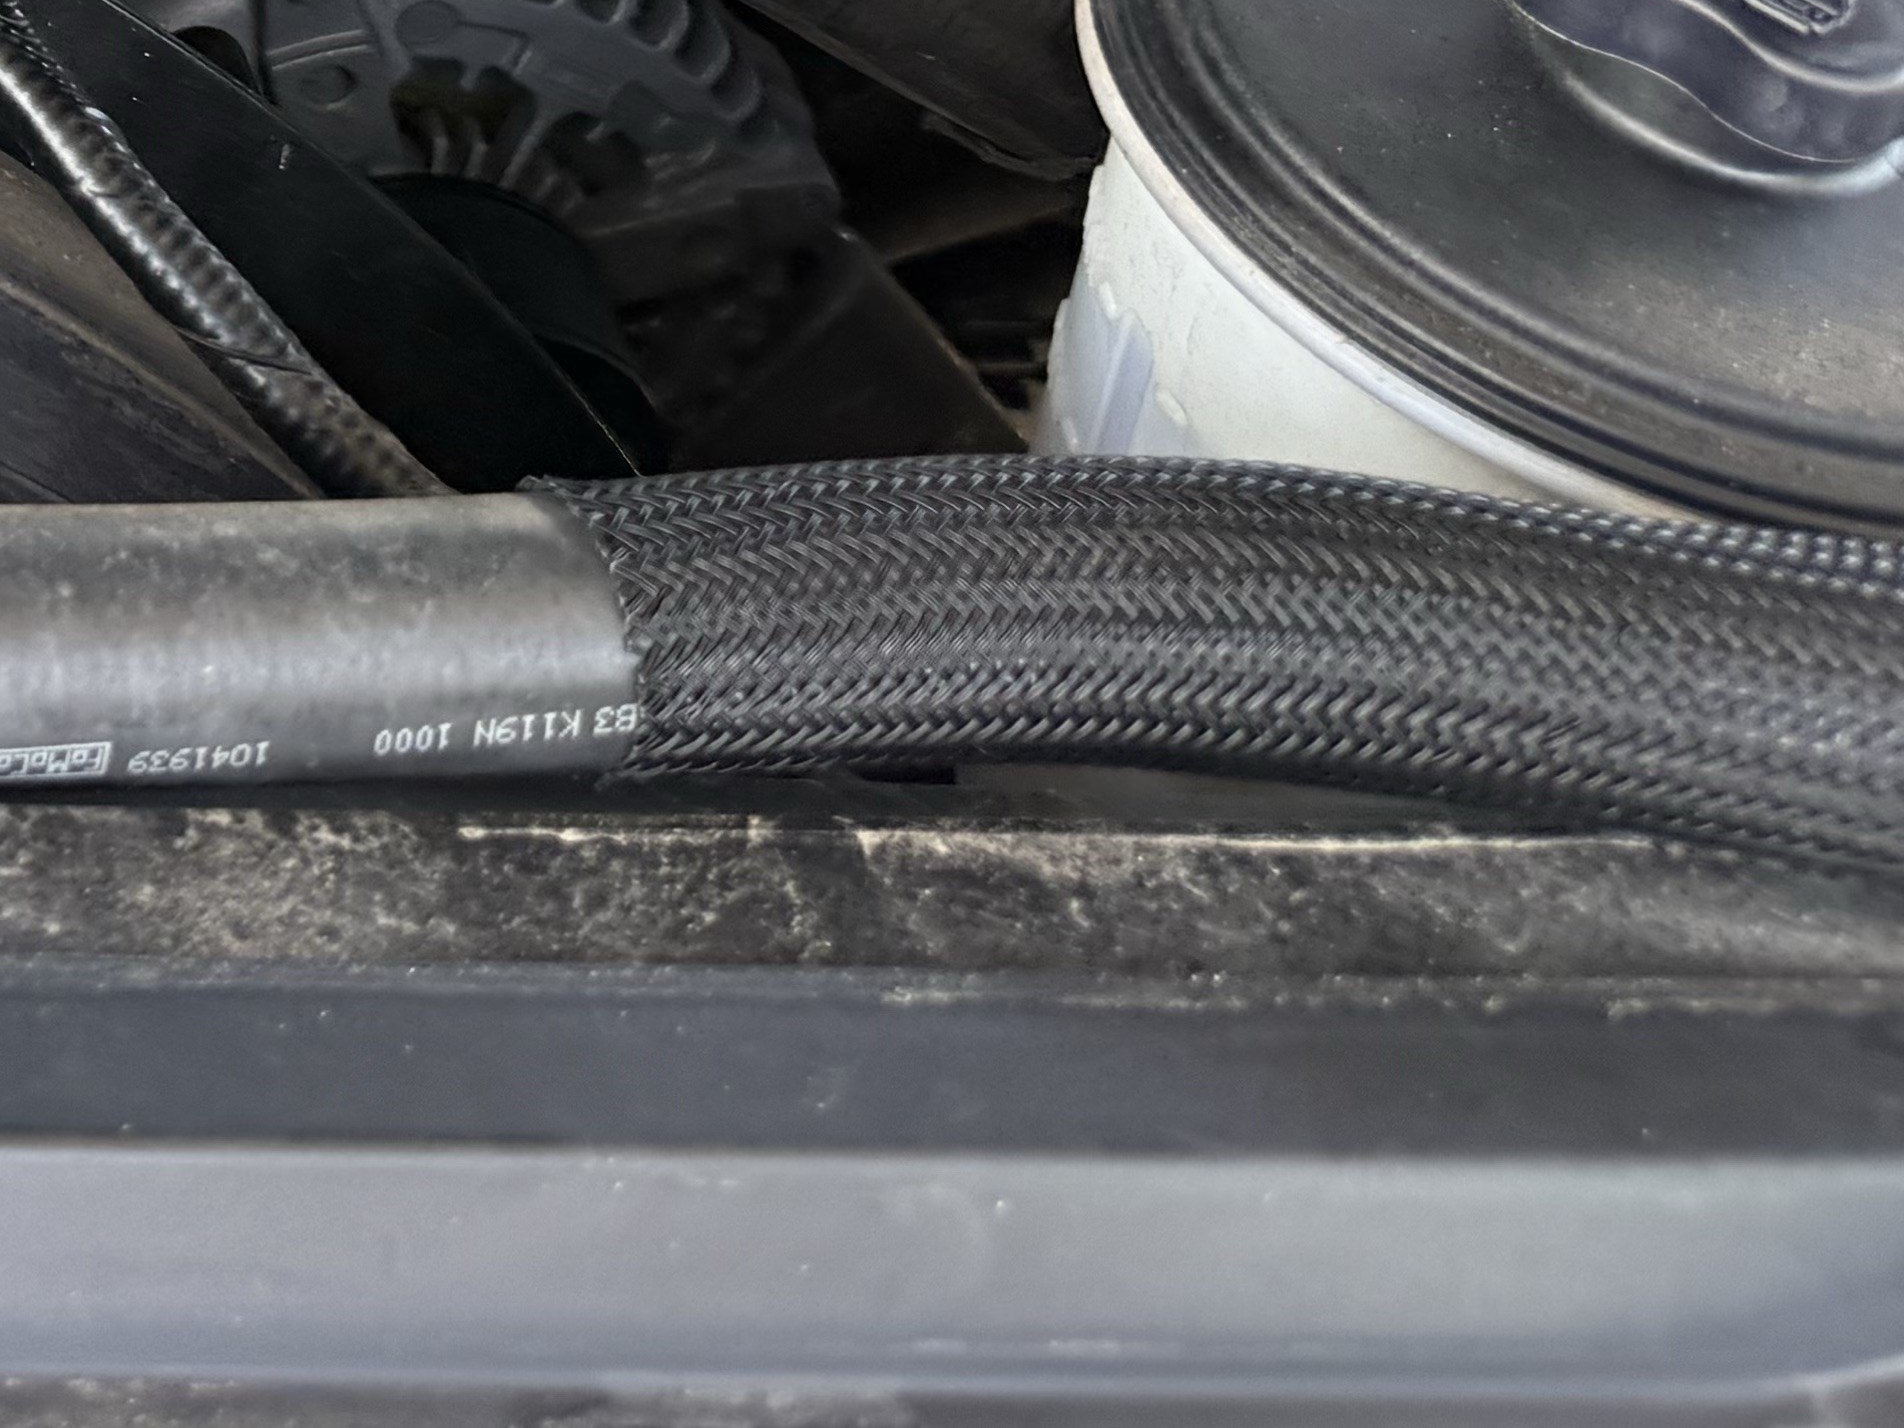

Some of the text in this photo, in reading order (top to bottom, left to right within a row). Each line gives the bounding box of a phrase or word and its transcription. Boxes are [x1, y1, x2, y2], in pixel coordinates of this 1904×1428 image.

[372, 720, 448, 755] 1000
[473, 707, 581, 749] K119N
[125, 739, 269, 775] 1041939
